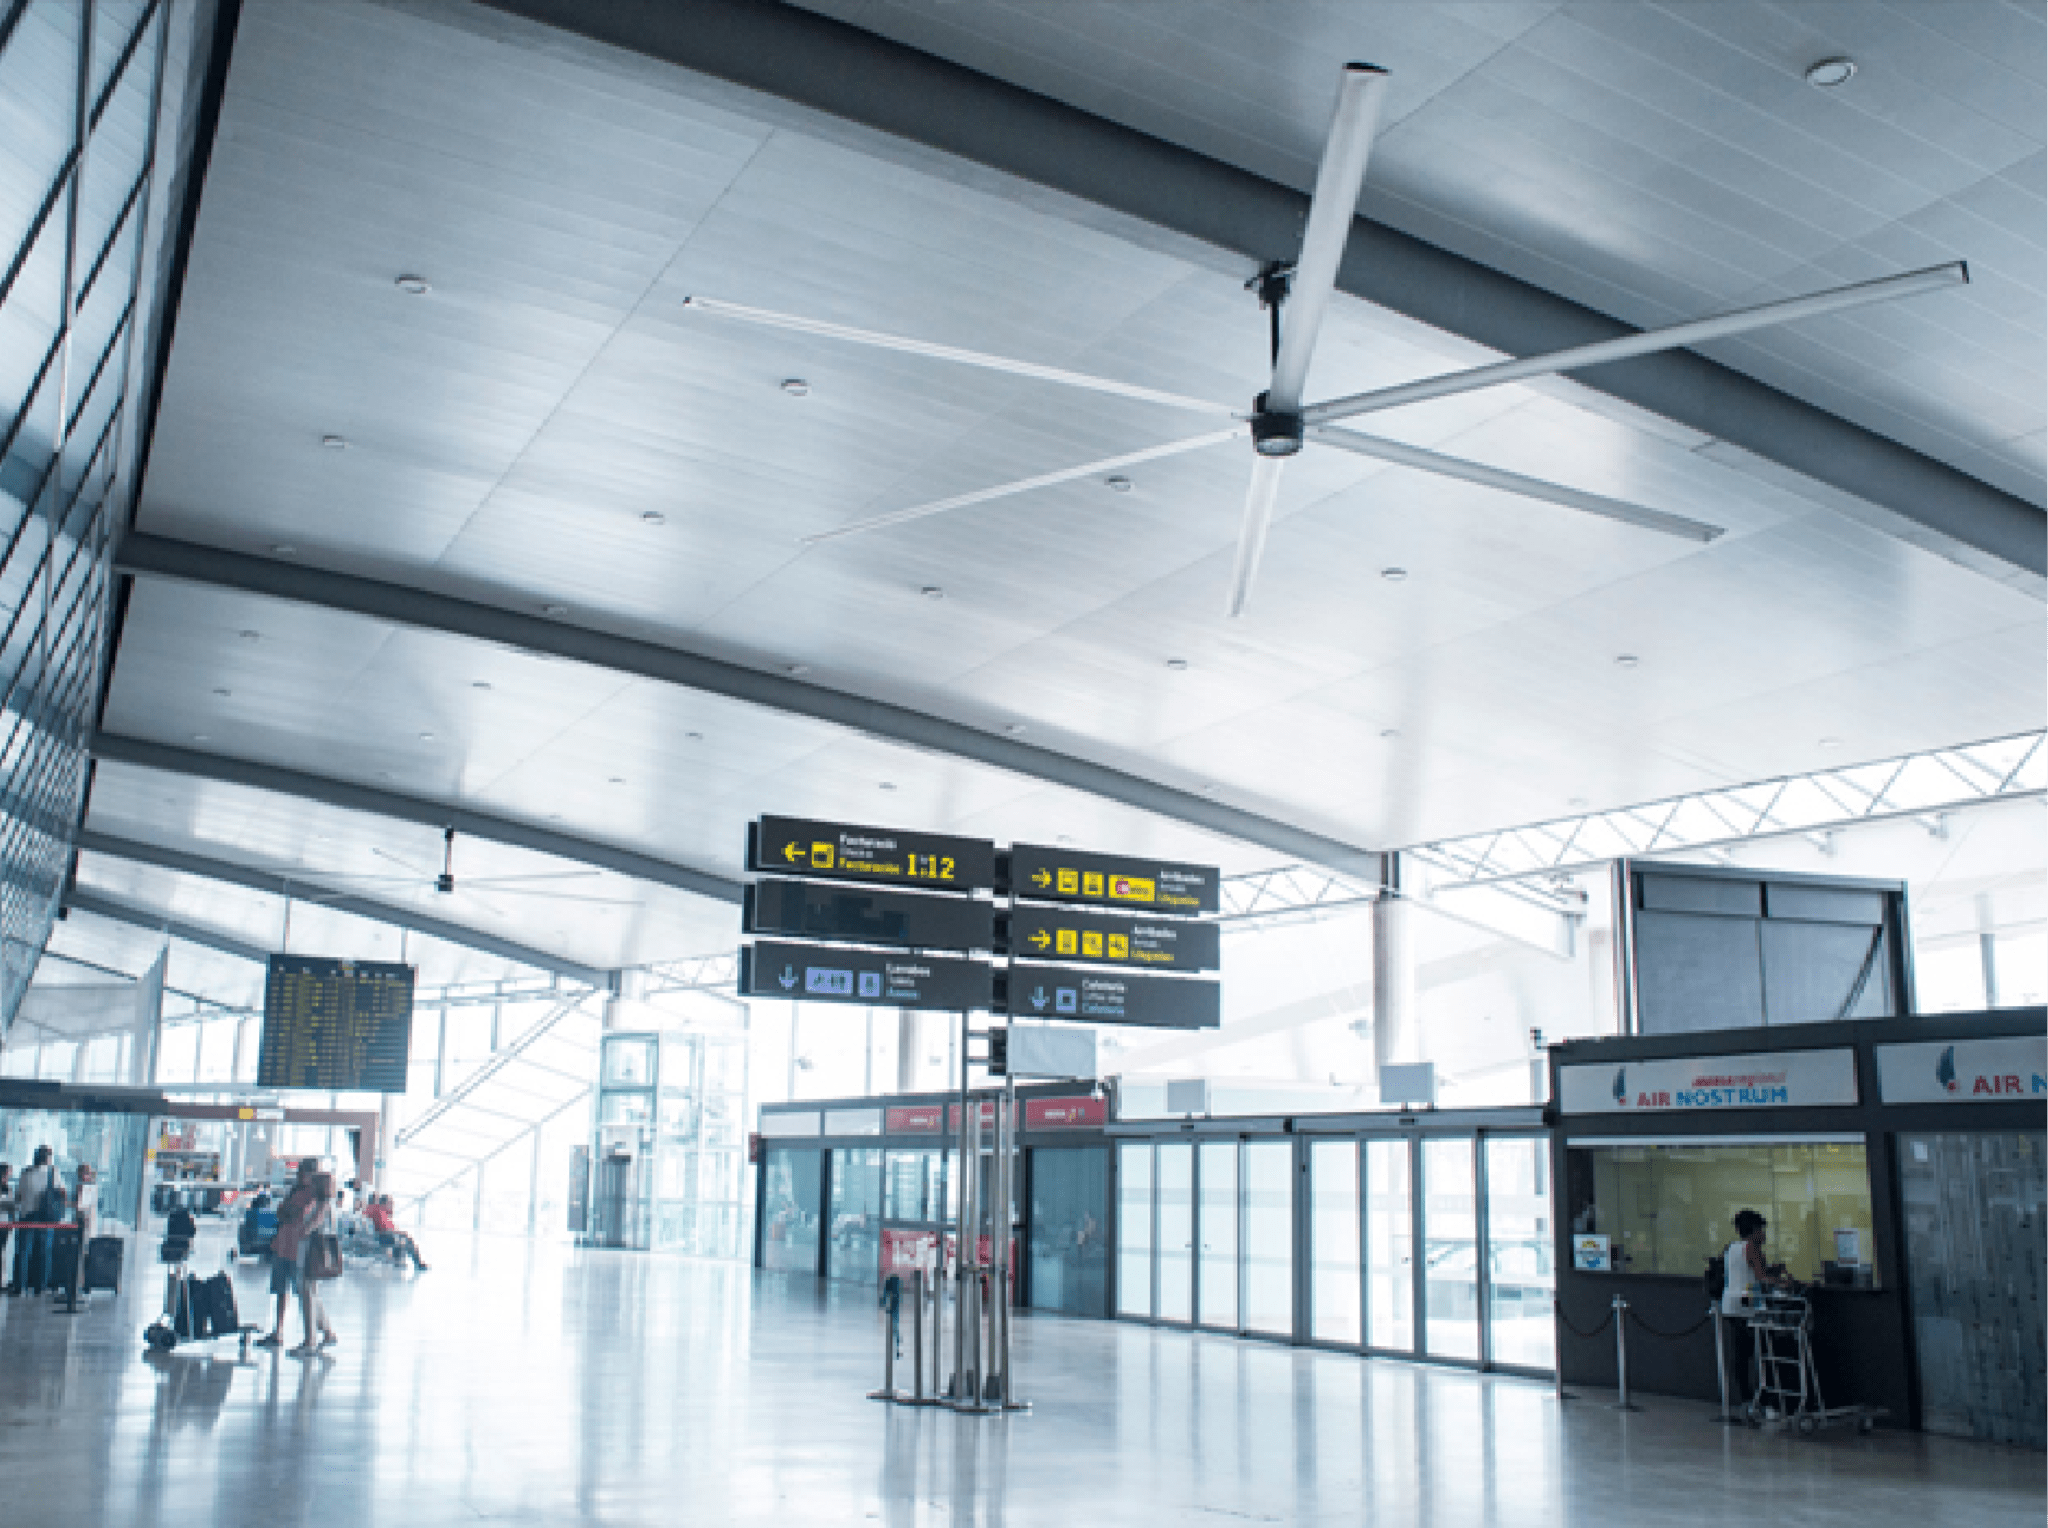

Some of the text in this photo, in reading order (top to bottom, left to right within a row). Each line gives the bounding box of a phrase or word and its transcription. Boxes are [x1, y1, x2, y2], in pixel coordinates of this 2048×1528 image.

[1972, 1074, 2024, 1096] AIR
[1637, 1086, 1789, 1107] AIR NOSTRUM
